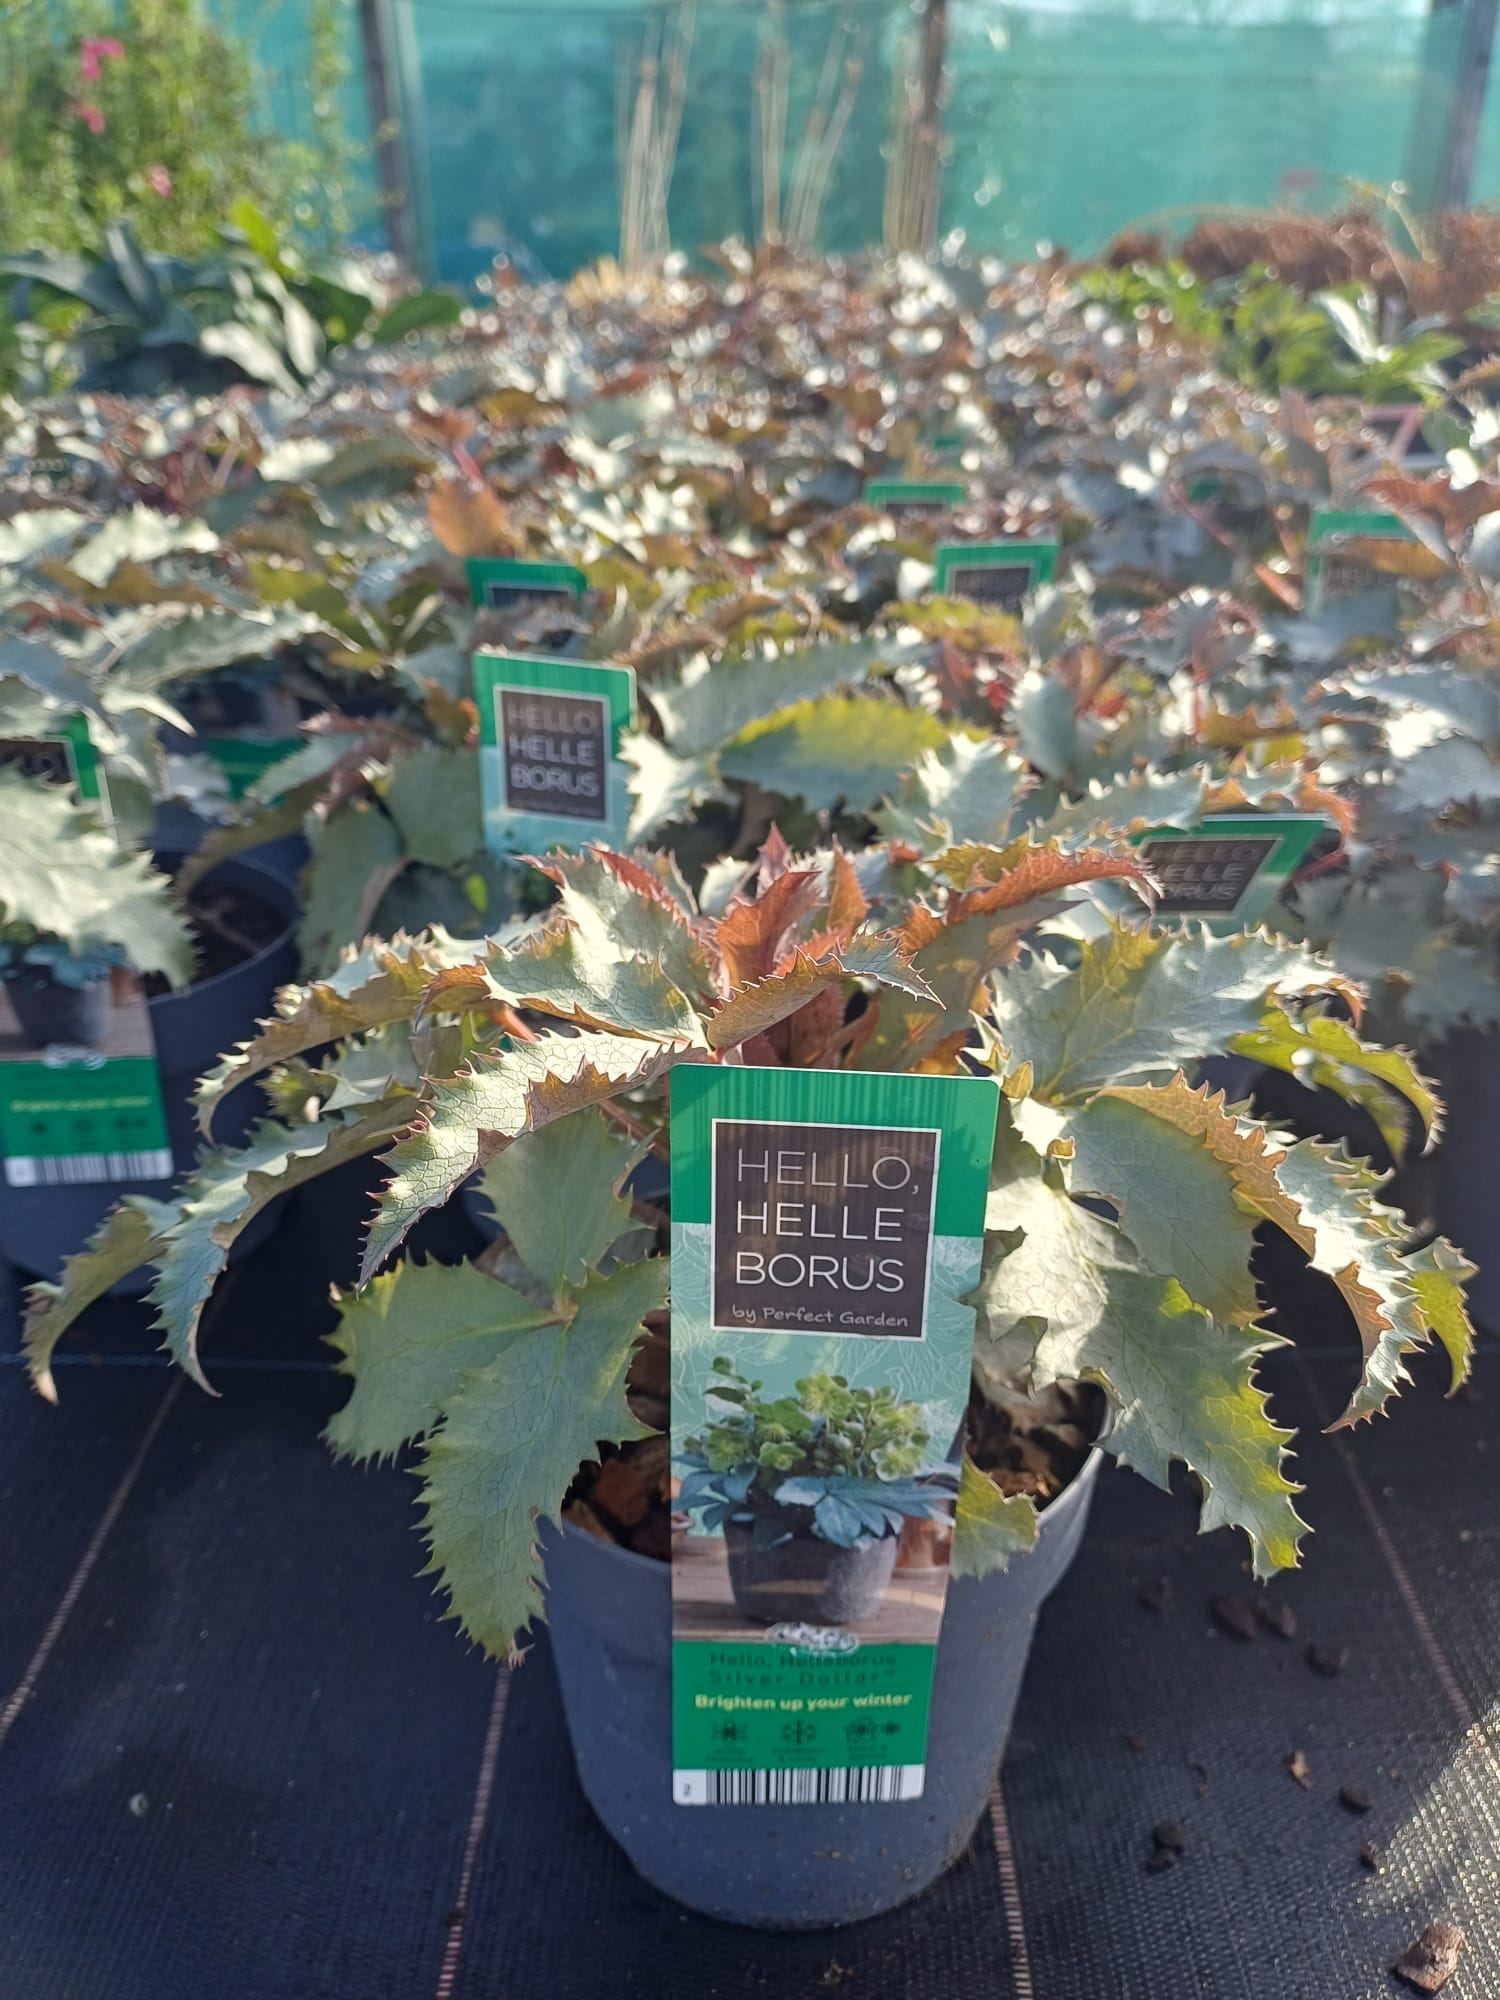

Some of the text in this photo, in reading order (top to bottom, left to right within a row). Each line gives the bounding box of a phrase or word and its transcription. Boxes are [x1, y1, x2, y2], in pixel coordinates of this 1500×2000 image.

[508, 732, 597, 767] HELLE
[509, 762, 600, 798] BORUS
[1157, 862, 1250, 881] ELLE
[737, 1148, 920, 1195] HELLO,
[736, 1200, 905, 1242] HELLE
[735, 1251, 905, 1293] BORUS
[732, 1304, 909, 1328] by Perfect Garden
[708, 1668, 783, 1686] Silver
[694, 1693, 913, 1712] Brighten up your winter
